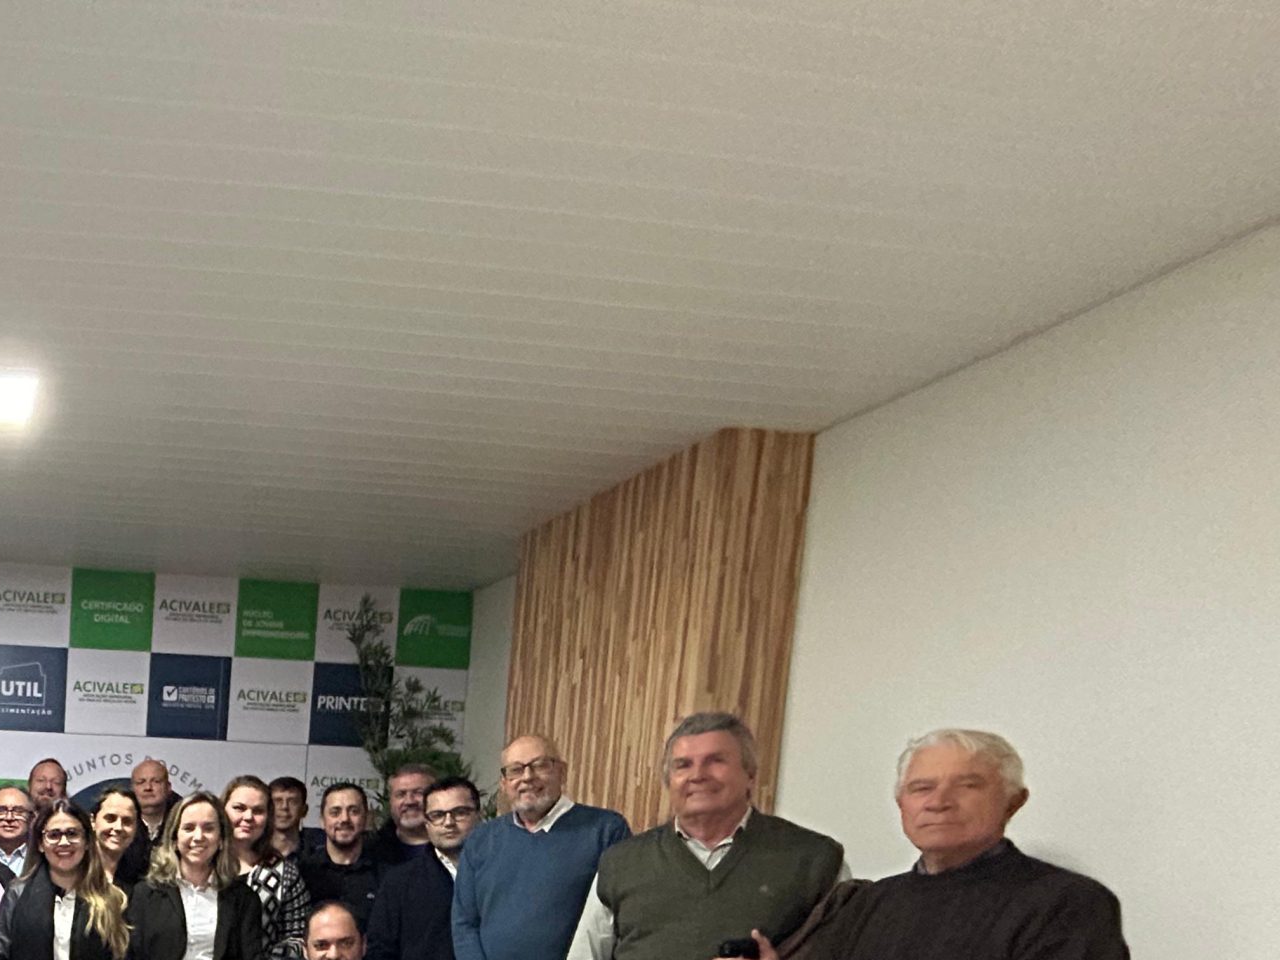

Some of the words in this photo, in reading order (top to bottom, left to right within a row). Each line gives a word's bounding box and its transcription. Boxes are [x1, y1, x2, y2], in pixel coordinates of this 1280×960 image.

[81, 600, 144, 612] CERTIFICADO
[159, 599, 215, 613] ACIVALE
[93, 614, 131, 624] DIGITAL
[1, 679, 43, 698] UTIL
[73, 681, 130, 694] ACIVALE
[237, 689, 295, 703] ACIVALE
[316, 695, 368, 712] PRINTE
[67, 753, 133, 781] JUNTOS
